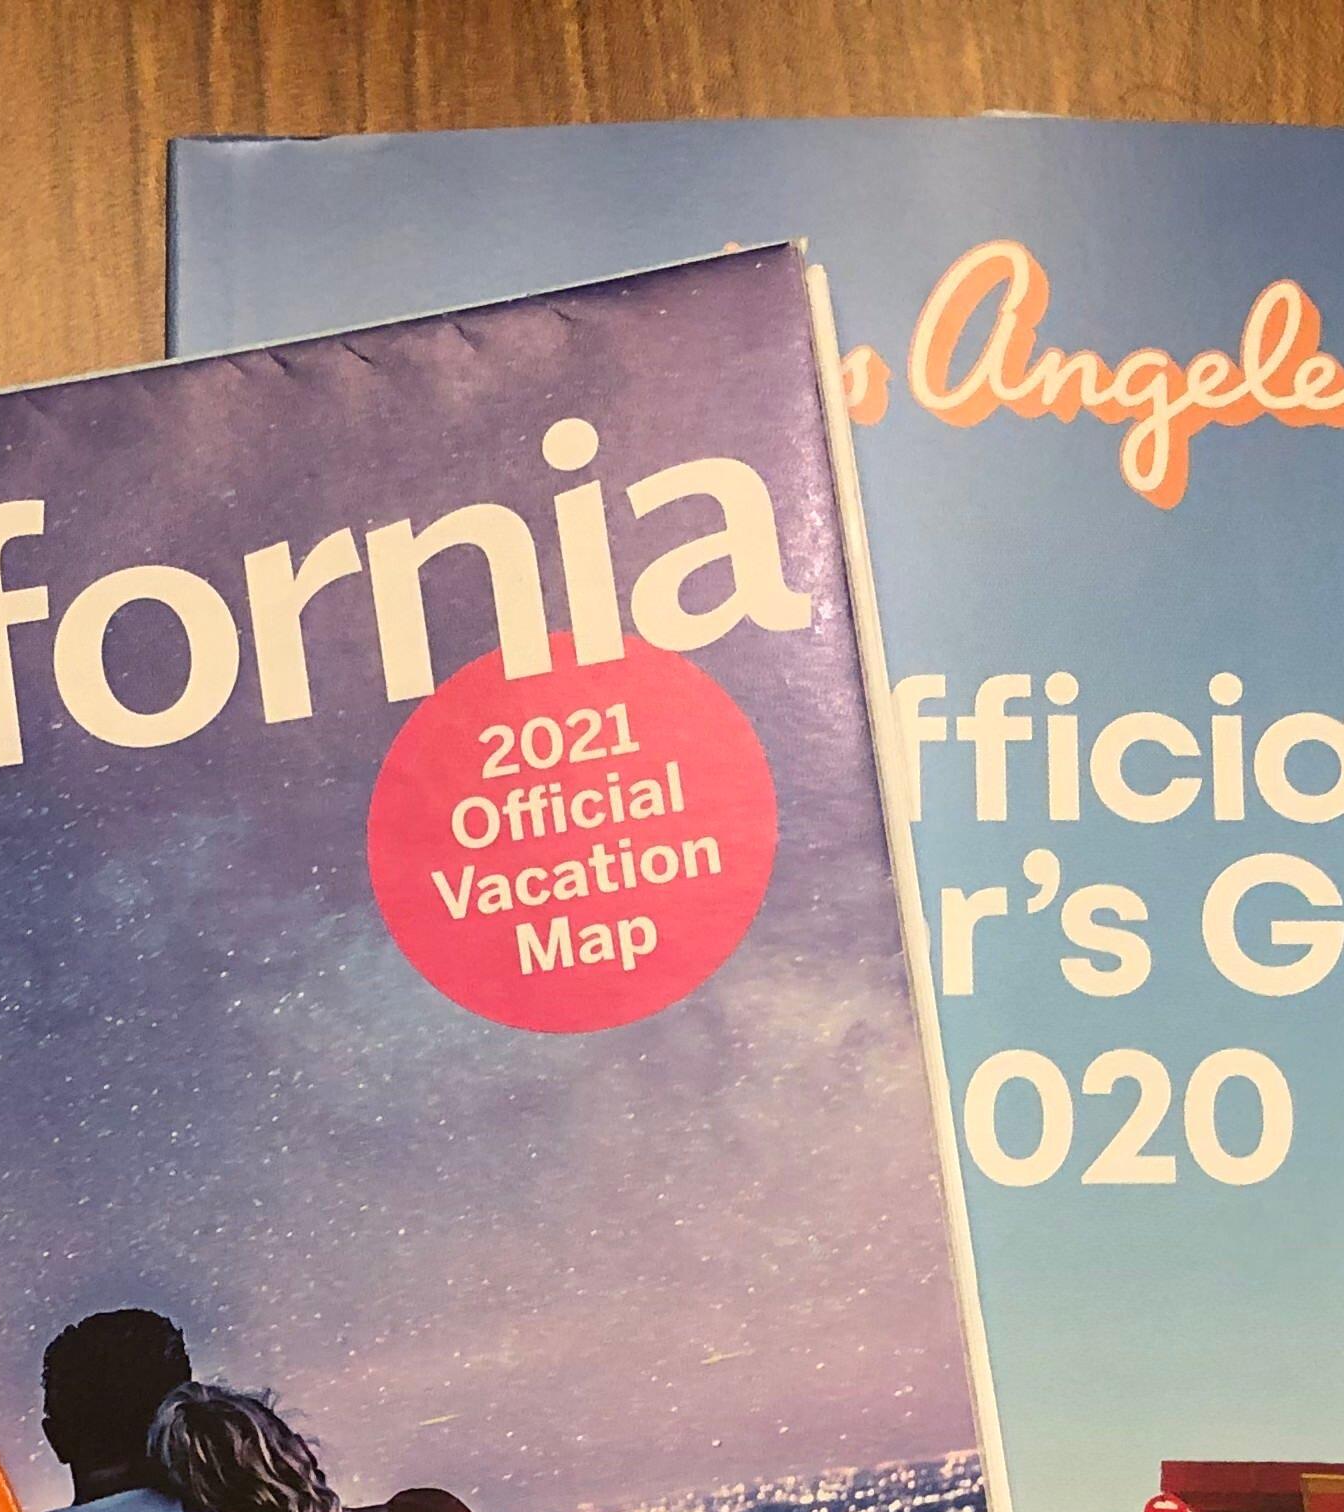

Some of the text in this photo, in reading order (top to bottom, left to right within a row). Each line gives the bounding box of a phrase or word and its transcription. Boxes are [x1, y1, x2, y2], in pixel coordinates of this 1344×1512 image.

[478, 703, 640, 781] 2021
[451, 762, 686, 852] Official
[432, 834, 723, 921] Vacation
[514, 911, 659, 977] Map
[963, 1047, 1294, 1187] 020
